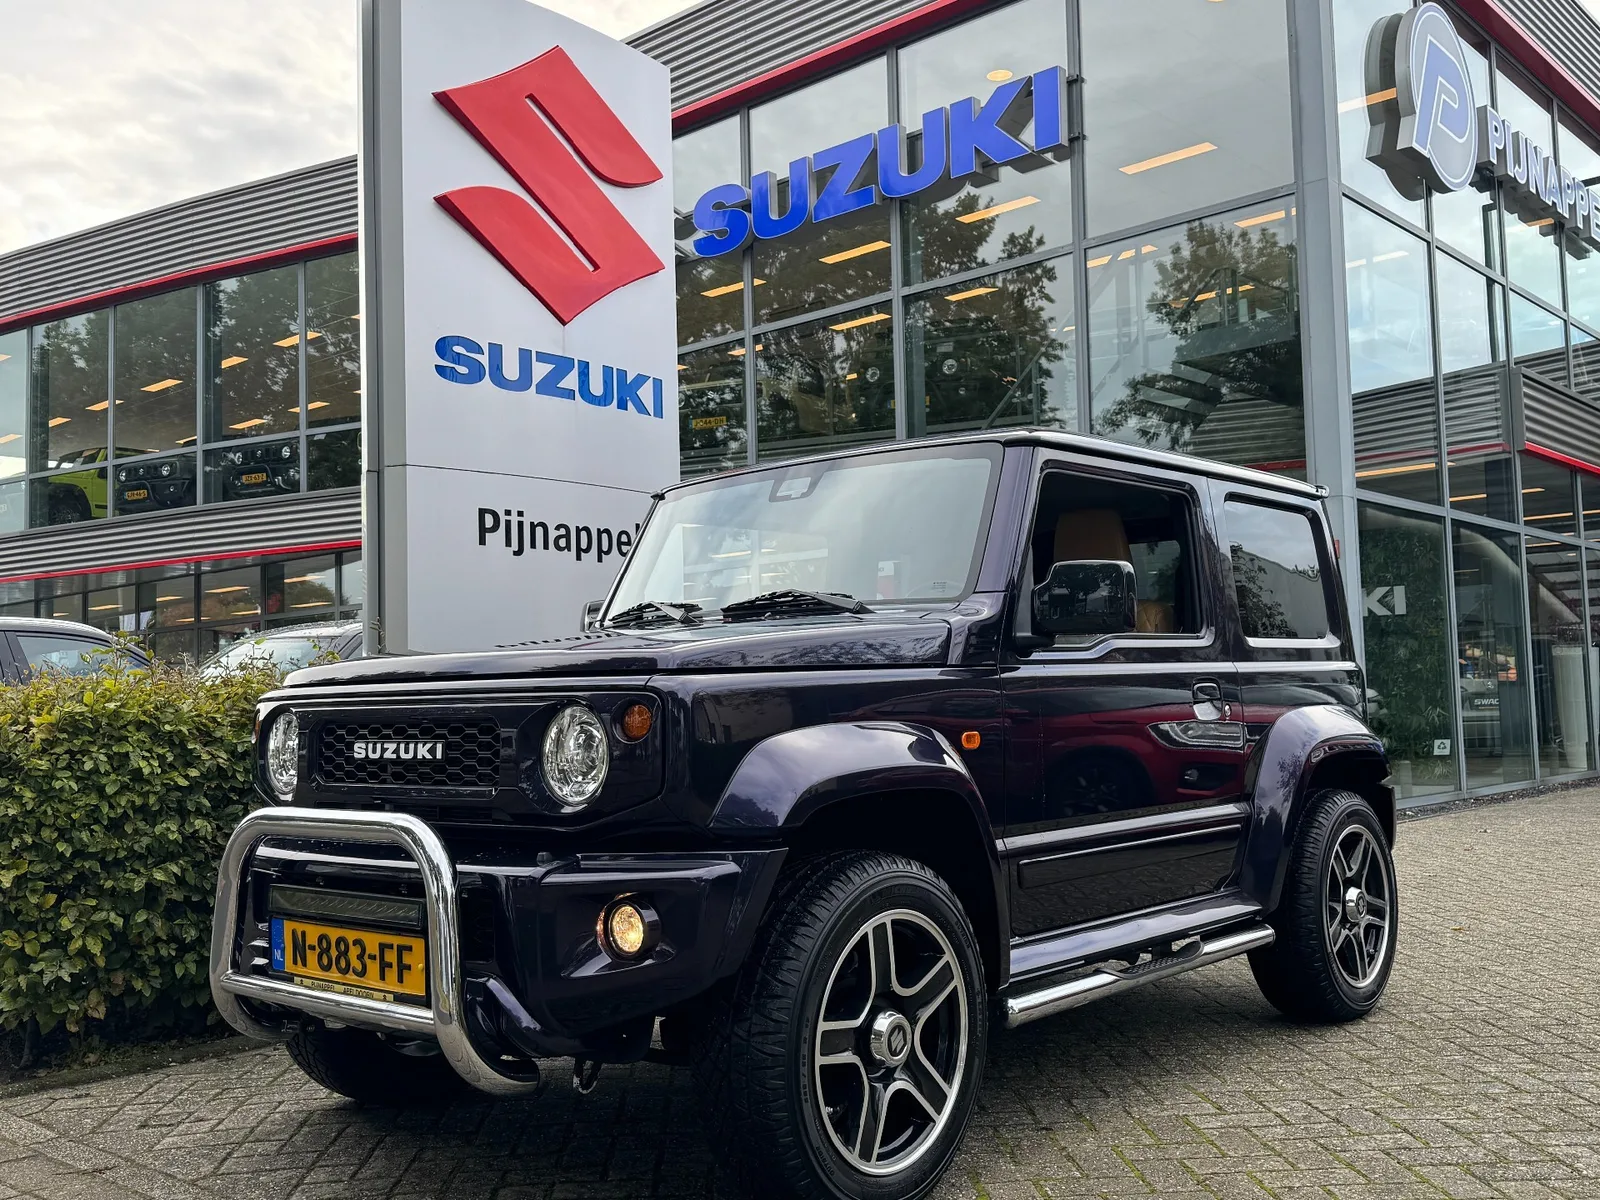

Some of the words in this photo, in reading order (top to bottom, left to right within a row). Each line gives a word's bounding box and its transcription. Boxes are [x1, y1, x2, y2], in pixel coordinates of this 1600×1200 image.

[692, 65, 1067, 257] SUZUKI
[1486, 104, 1600, 243] PIJNAPPE
[434, 335, 664, 420] SUZUKI
[477, 507, 641, 563] Pijnappe
[353, 741, 443, 760] SUZUKI
[274, 949, 284, 961] NL
[291, 928, 413, 984] N-883-FF
